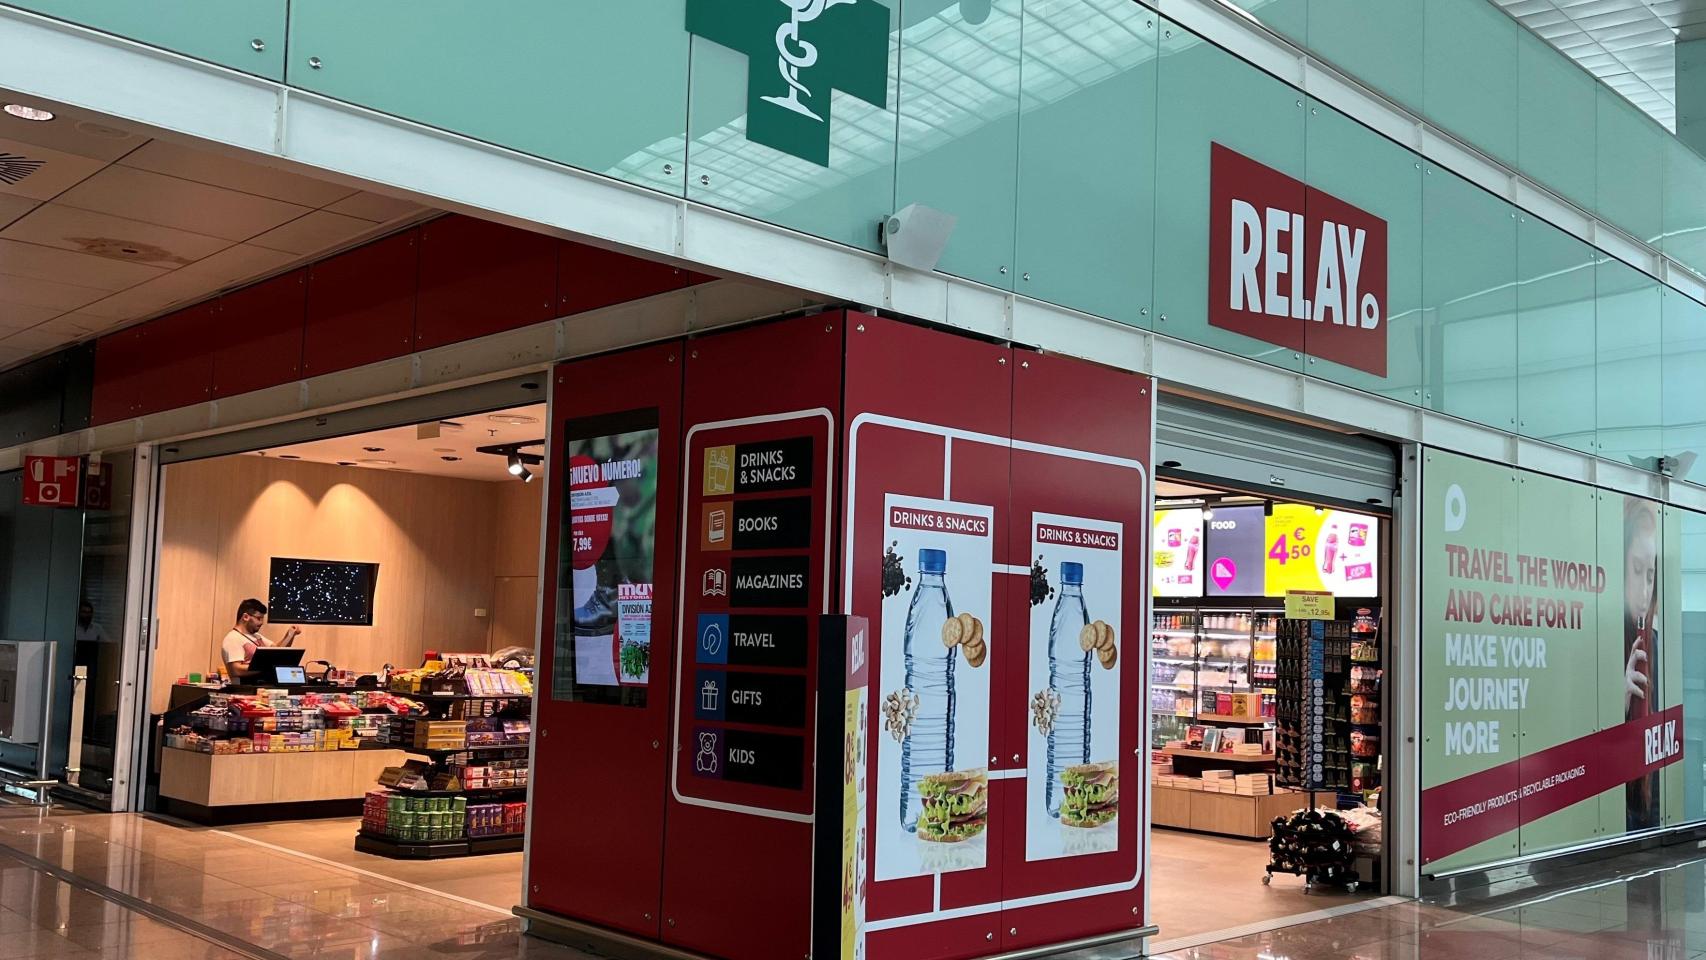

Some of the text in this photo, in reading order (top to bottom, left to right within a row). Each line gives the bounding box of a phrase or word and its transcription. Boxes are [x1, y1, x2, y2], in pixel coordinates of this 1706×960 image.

[740, 450, 784, 468] DRINKS
[569, 458, 641, 486] ¡NUEVO NÚMERO!
[740, 466, 796, 485] & SNACKS
[738, 516, 778, 532] BOOKS
[893, 511, 986, 533] DRINKS & SNACKS
[1211, 520, 1236, 530] FOOD
[573, 536, 593, 552] 7,99€
[1039, 527, 1116, 548] DRINKS & SNACKS
[1445, 543, 1606, 594] TRAVEL THE WORLD
[735, 573, 803, 589] MAGAZINES
[1302, 595, 1319, 603] SAVE
[1445, 588, 1584, 630] AND CARE FOR IT
[733, 632, 776, 648] TRAVEL
[1445, 632, 1547, 668] MAKE YOUR
[731, 690, 762, 706] GIFTS
[1444, 677, 1530, 711] JOURNEY
[1445, 720, 1500, 756] MORE
[729, 748, 755, 765] KIDS
[1444, 801, 1488, 826] ECO-FRIENDLY
[1487, 790, 1518, 811] PRODUCTS
[1522, 776, 1555, 796] RECYCLABLE
[1555, 765, 1586, 784] PACKAGINGS
